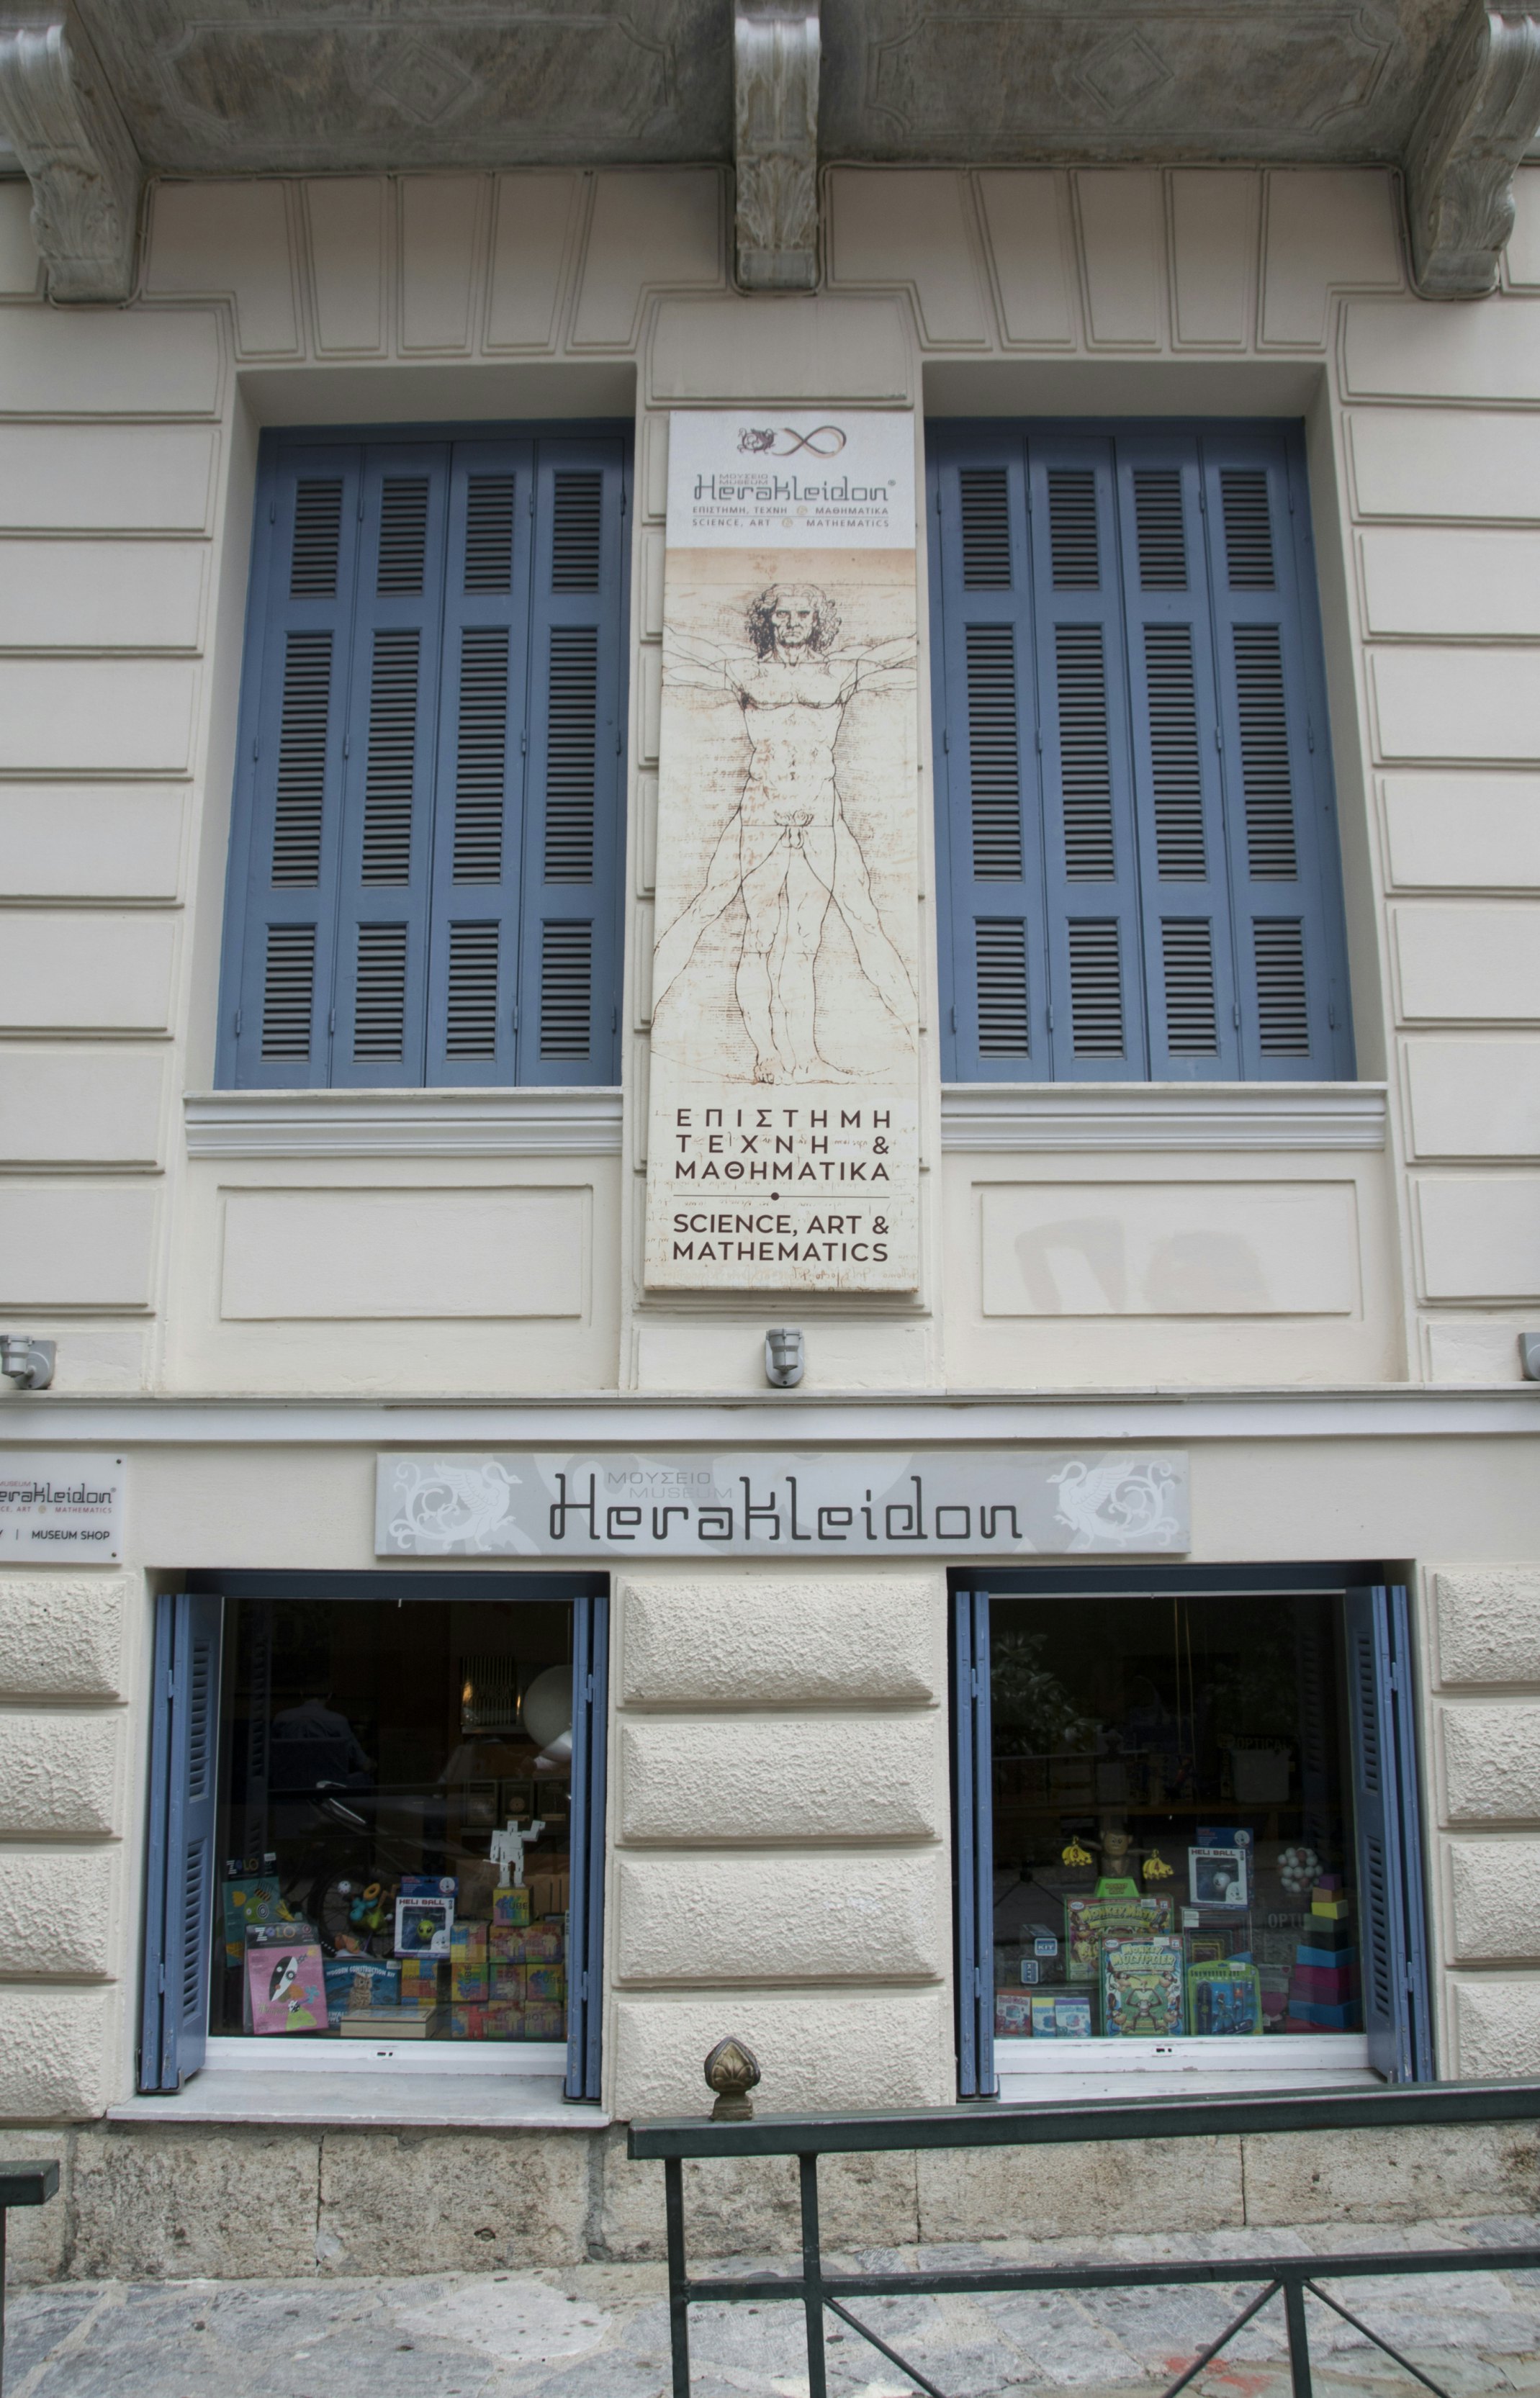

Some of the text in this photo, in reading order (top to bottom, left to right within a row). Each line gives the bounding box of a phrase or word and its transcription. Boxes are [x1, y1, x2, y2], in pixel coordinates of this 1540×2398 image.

[692, 505, 889, 515] ΕΠΙΣΤΗΜΗ, ΤΕΧΝΗ ΜΑΘΗΜΑΤΙΚΑ
[692, 518, 889, 528] SCIENCE, ART MATHEMATICS
[677, 1108, 891, 1129] ΕΠΙΣΤΗΜΗ
[675, 1134, 890, 1155] ΤΕΧΝΗ &
[675, 1160, 891, 1181] ΜΑΘΗΜΑΤΙΚΑ
[673, 1213, 890, 1237] SCIENCE, ART &
[672, 1240, 889, 1262] MATHEMATICS
[607, 1471, 711, 1485] ΜΟΥΣΕΙΟ
[629, 1487, 733, 1500] MUSEUM
[549, 1472, 1023, 1541] Herakleidon
[32, 1530, 110, 1541] MUSEUM SHOP
[1073, 1849, 1079, 1858] 3
[254, 1926, 296, 1942] ZOLO
[1122, 1945, 1163, 1955] MONKEY
[1111, 1953, 1175, 1966] MULTIPLIER
[326, 1966, 348, 1976] WOODEN
[349, 1965, 387, 1977] CONSTRUCTION
